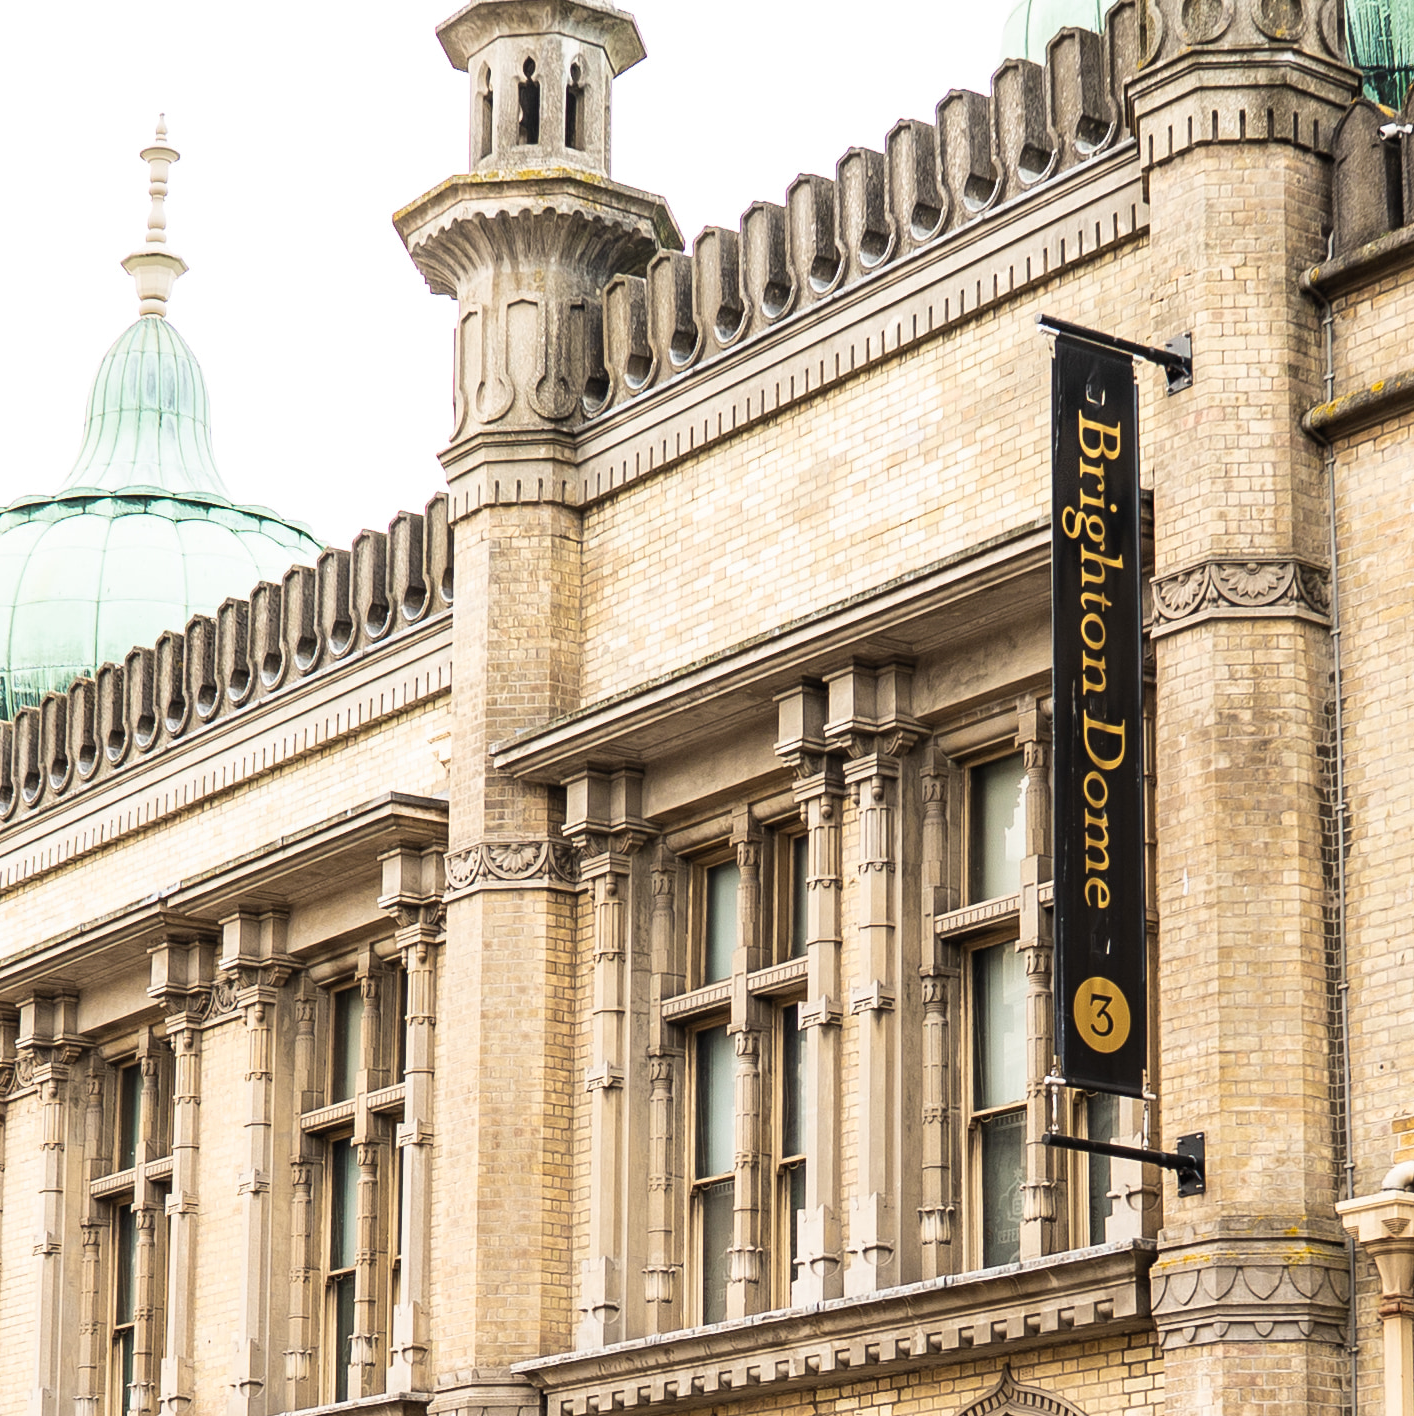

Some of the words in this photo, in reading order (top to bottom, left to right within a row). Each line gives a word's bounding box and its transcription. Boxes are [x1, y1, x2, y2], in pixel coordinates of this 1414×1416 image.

[1061, 409, 1124, 696] Brighton
[1083, 708, 1126, 909] Dome
[1089, 993, 1114, 1034] 3
